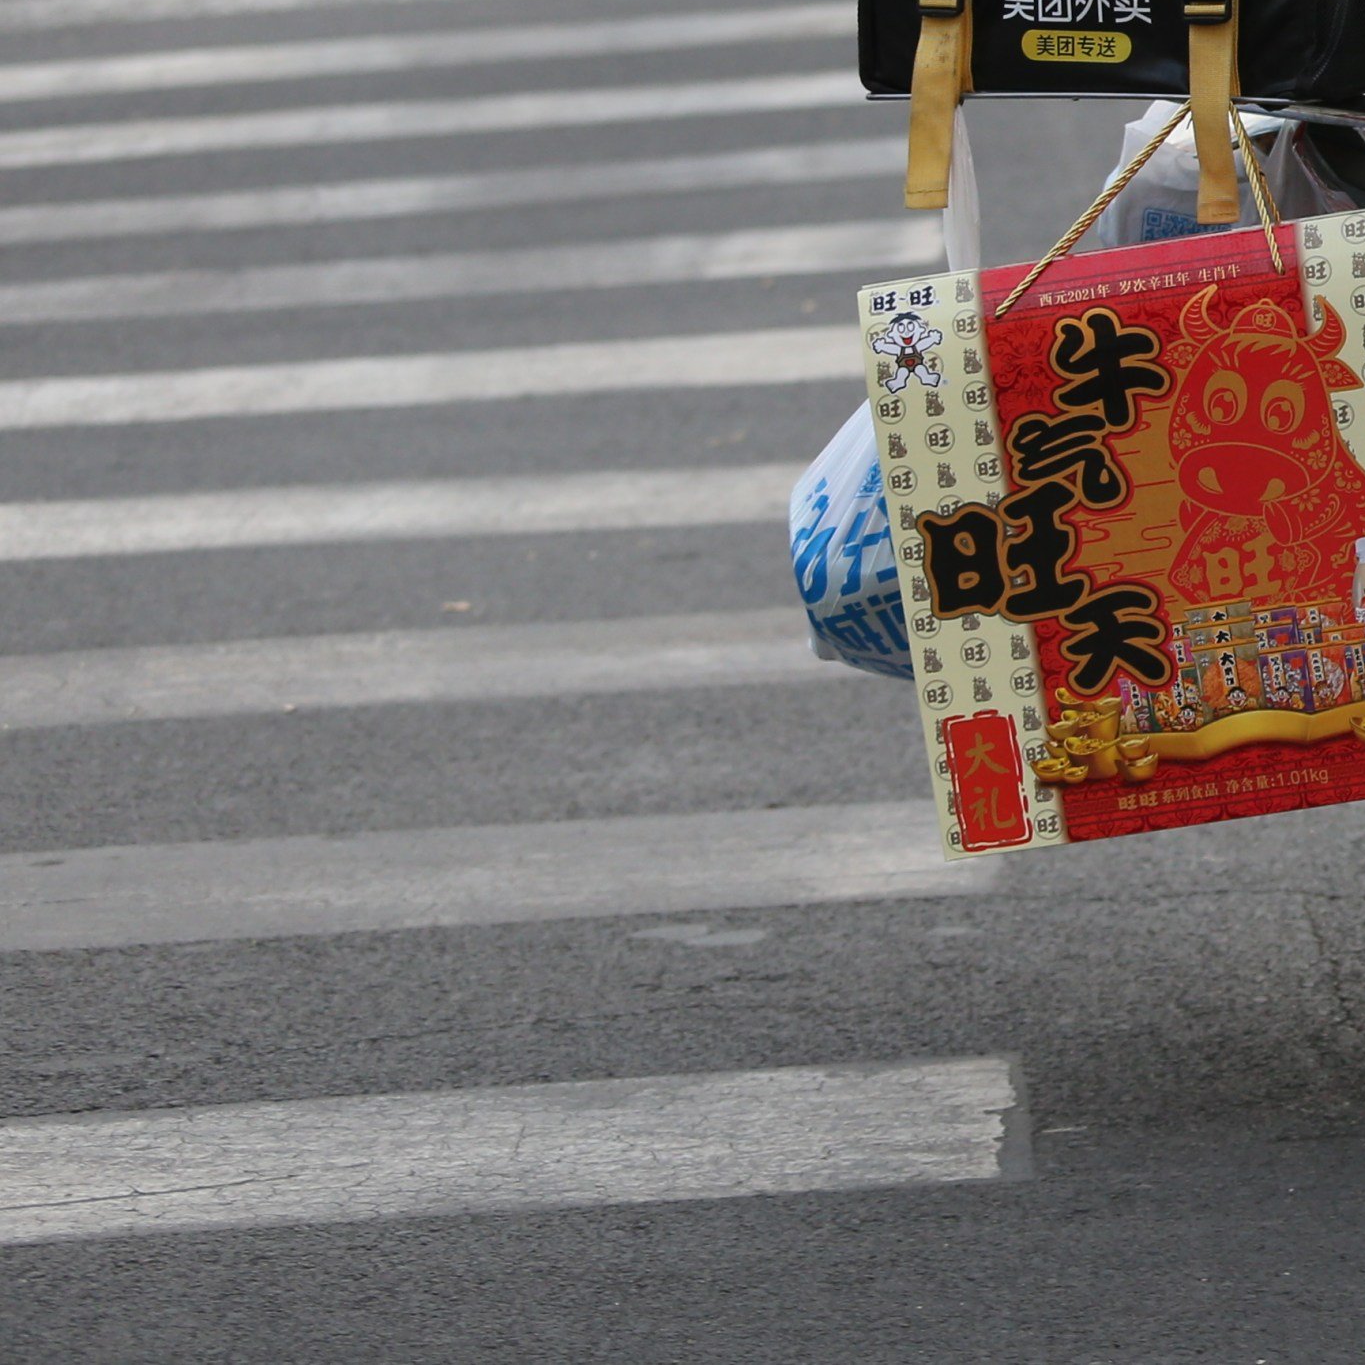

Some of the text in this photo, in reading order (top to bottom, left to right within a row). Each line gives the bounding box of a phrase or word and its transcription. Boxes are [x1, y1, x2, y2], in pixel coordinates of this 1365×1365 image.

[1036, 34, 1117, 59] 美团专送
[1305, 261, 1328, 279] 旺
[1038, 263, 1242, 308] 西元2021年 岁次辛丑年 生肖牛
[956, 316, 977, 332] 旺
[1256, 316, 1274, 328] 旺
[966, 387, 988, 404] 旺
[879, 399, 901, 418] 旺
[928, 429, 950, 447] 旺
[978, 458, 1000, 476] 旺
[891, 471, 913, 489] 旺
[1202, 532, 1282, 598] 旺
[914, 616, 937, 633] 旺
[963, 643, 985, 662] 旺
[1013, 672, 1036, 692] 旺
[926, 685, 947, 704] 旺
[962, 731, 1017, 832] 大礼
[1117, 767, 1330, 811] 旺旺系列食品 净含量:1.01kg
[1037, 814, 1059, 833] 旺
